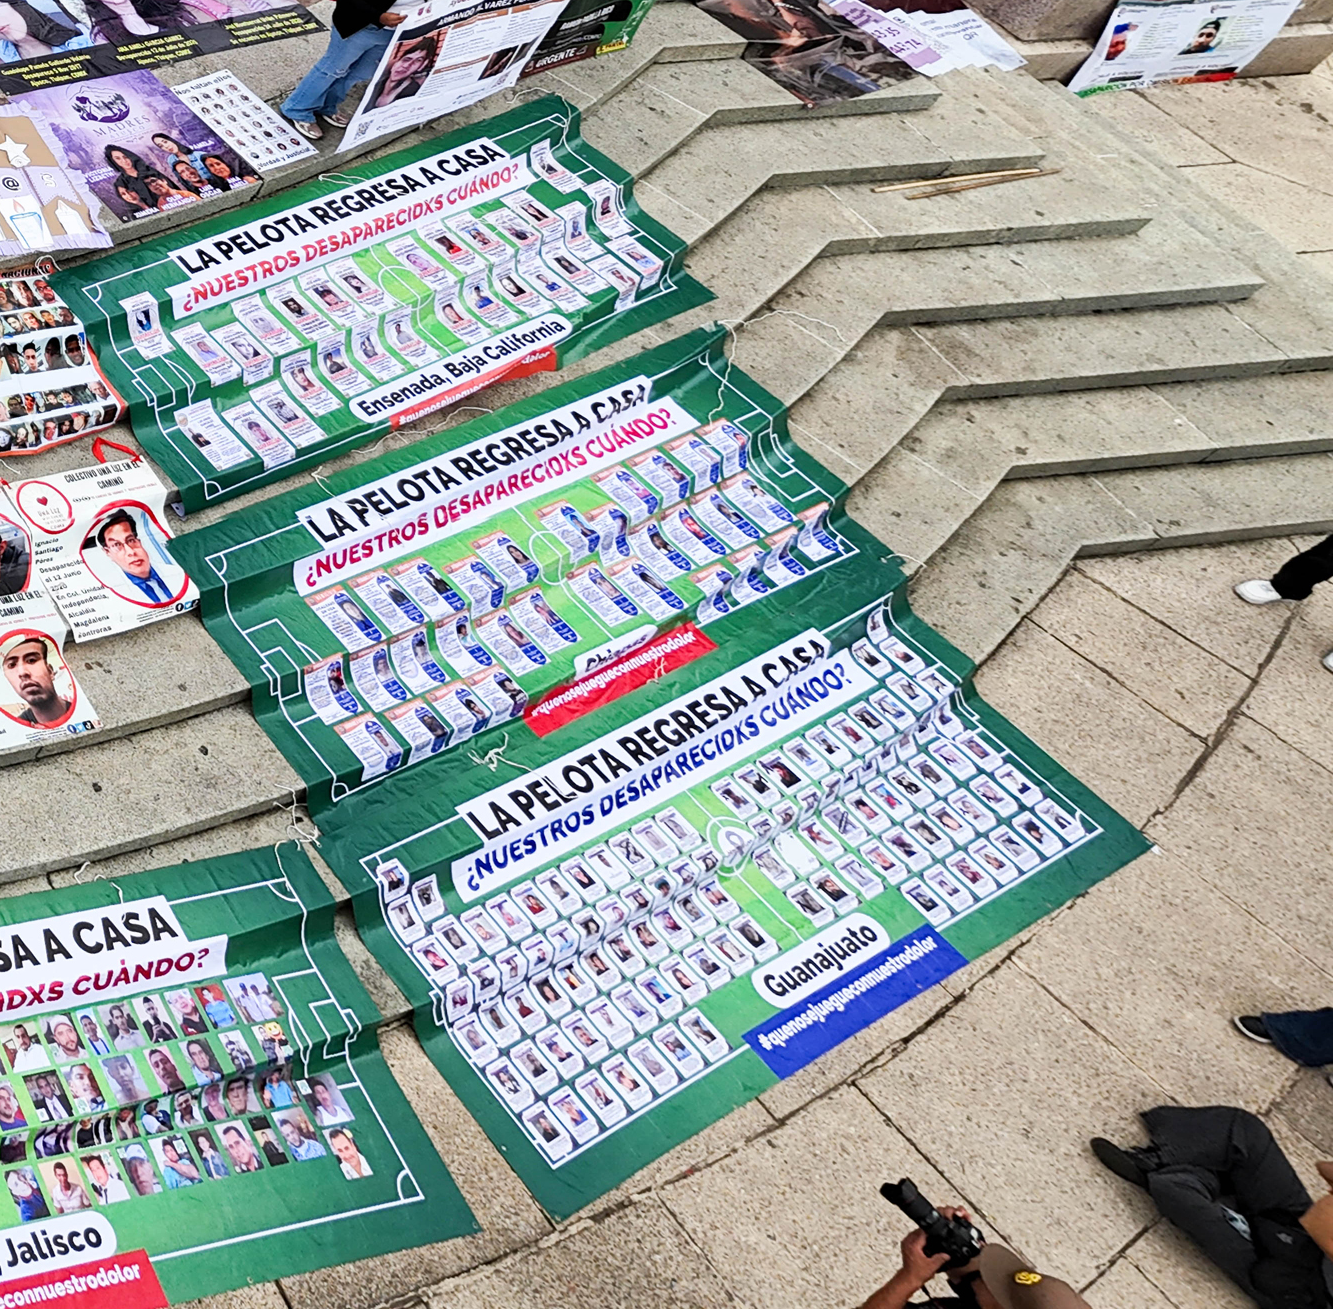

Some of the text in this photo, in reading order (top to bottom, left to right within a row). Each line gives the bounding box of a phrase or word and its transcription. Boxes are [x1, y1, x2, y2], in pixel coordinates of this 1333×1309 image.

[357, 318, 566, 418] Ensenada, Baja California
[42, 927, 72, 963] A
[71, 907, 179, 954] CASA
[762, 922, 879, 995] Guanajuato
[6, 1227, 103, 1269] Jalisco
